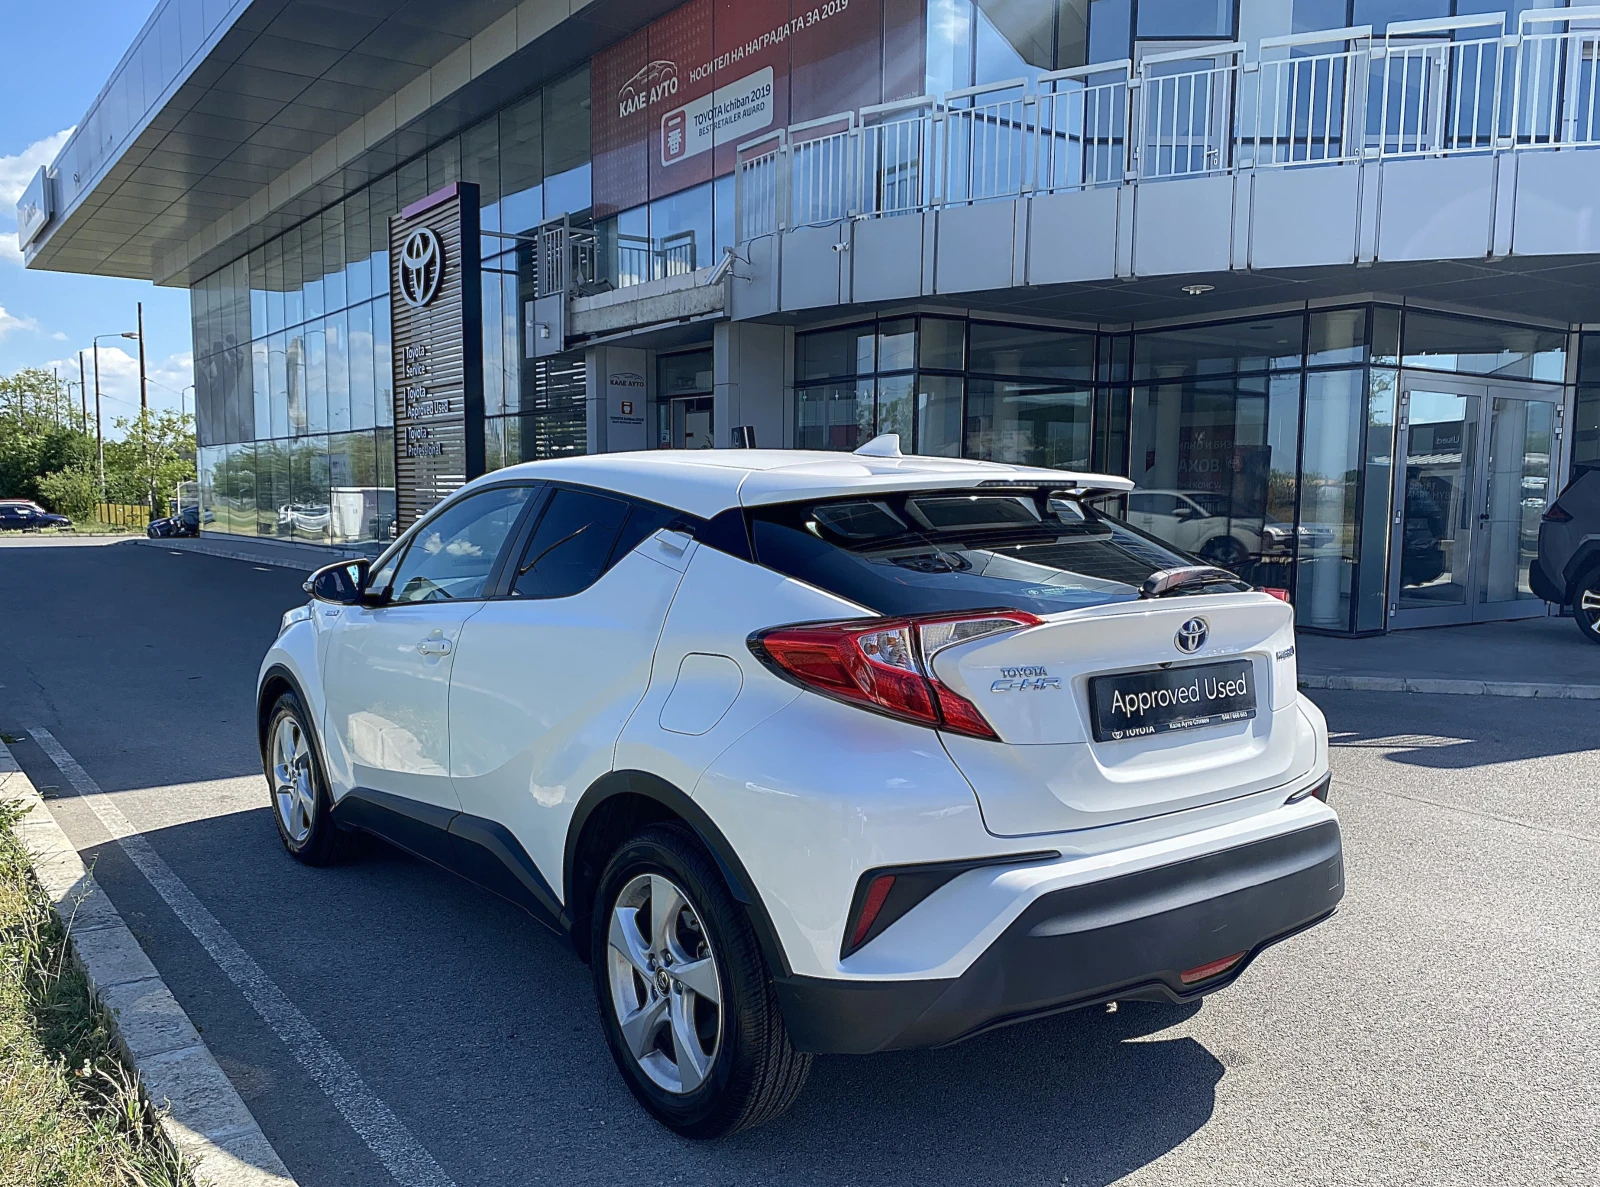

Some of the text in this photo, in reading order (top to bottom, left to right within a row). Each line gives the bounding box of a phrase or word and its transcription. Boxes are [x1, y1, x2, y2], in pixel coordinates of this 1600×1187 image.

[689, 53, 729, 83] НОСИТЕЛ
[731, 46, 744, 63] НА
[806, 9, 820, 27] ЗА
[821, 0, 849, 19] 2019
[619, 77, 678, 118] КАЛЕ АУТО
[694, 83, 771, 126] TOYOTA Ichiban 2019
[698, 101, 765, 137] BEST RETAILER AWARD
[405, 345, 425, 360] Toyota
[406, 364, 426, 377] Service
[407, 387, 426, 401] Toyota
[407, 401, 449, 419] Approved Used
[407, 427, 427, 441] Toyota
[408, 443, 441, 457] Professional
[1000, 666, 1048, 678] TOYOTA
[990, 677, 1062, 692] C-HR
[1111, 672, 1247, 718] Approved Used
[1126, 726, 1155, 737] TOYOTA
